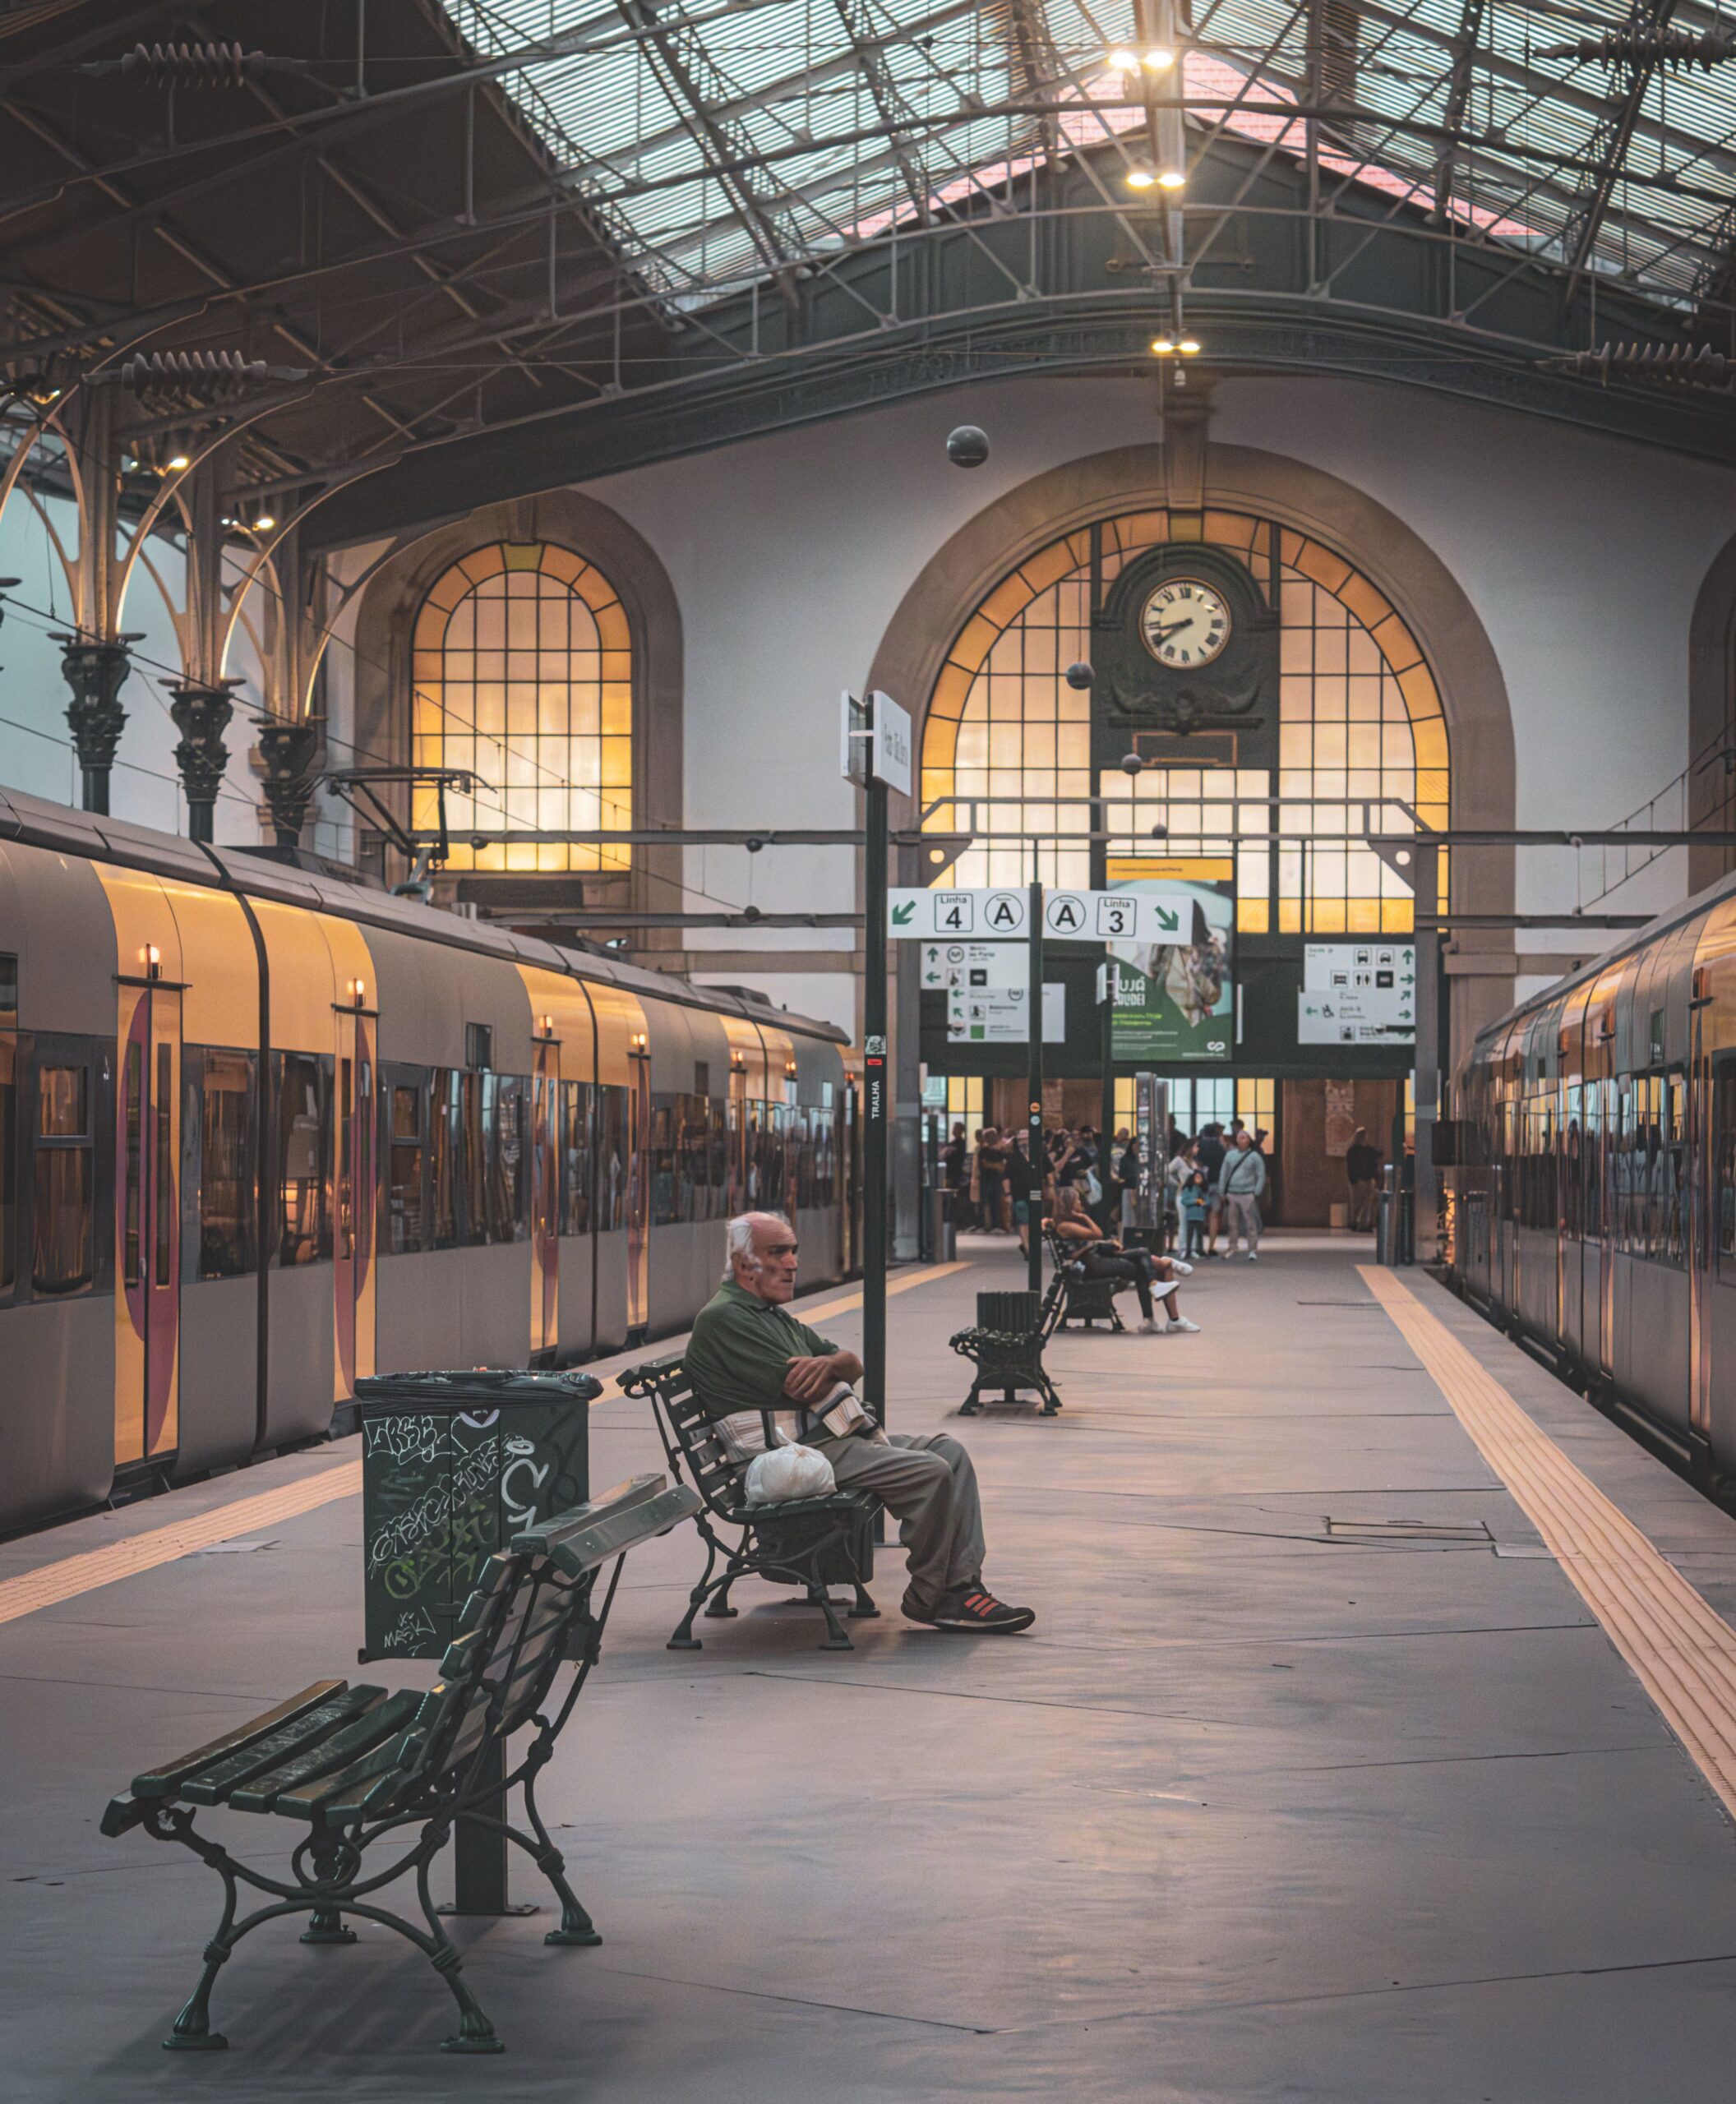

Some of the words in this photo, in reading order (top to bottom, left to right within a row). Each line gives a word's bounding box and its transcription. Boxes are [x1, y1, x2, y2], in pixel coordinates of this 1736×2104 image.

[940, 895, 967, 904] Linha
[1104, 898, 1131, 908] Linha
[945, 906, 963, 929] 4
[993, 902, 1015, 925] A
[1055, 904, 1077, 927] A
[1109, 910, 1124, 934] 3
[871, 1080, 880, 1119] TRALHA
